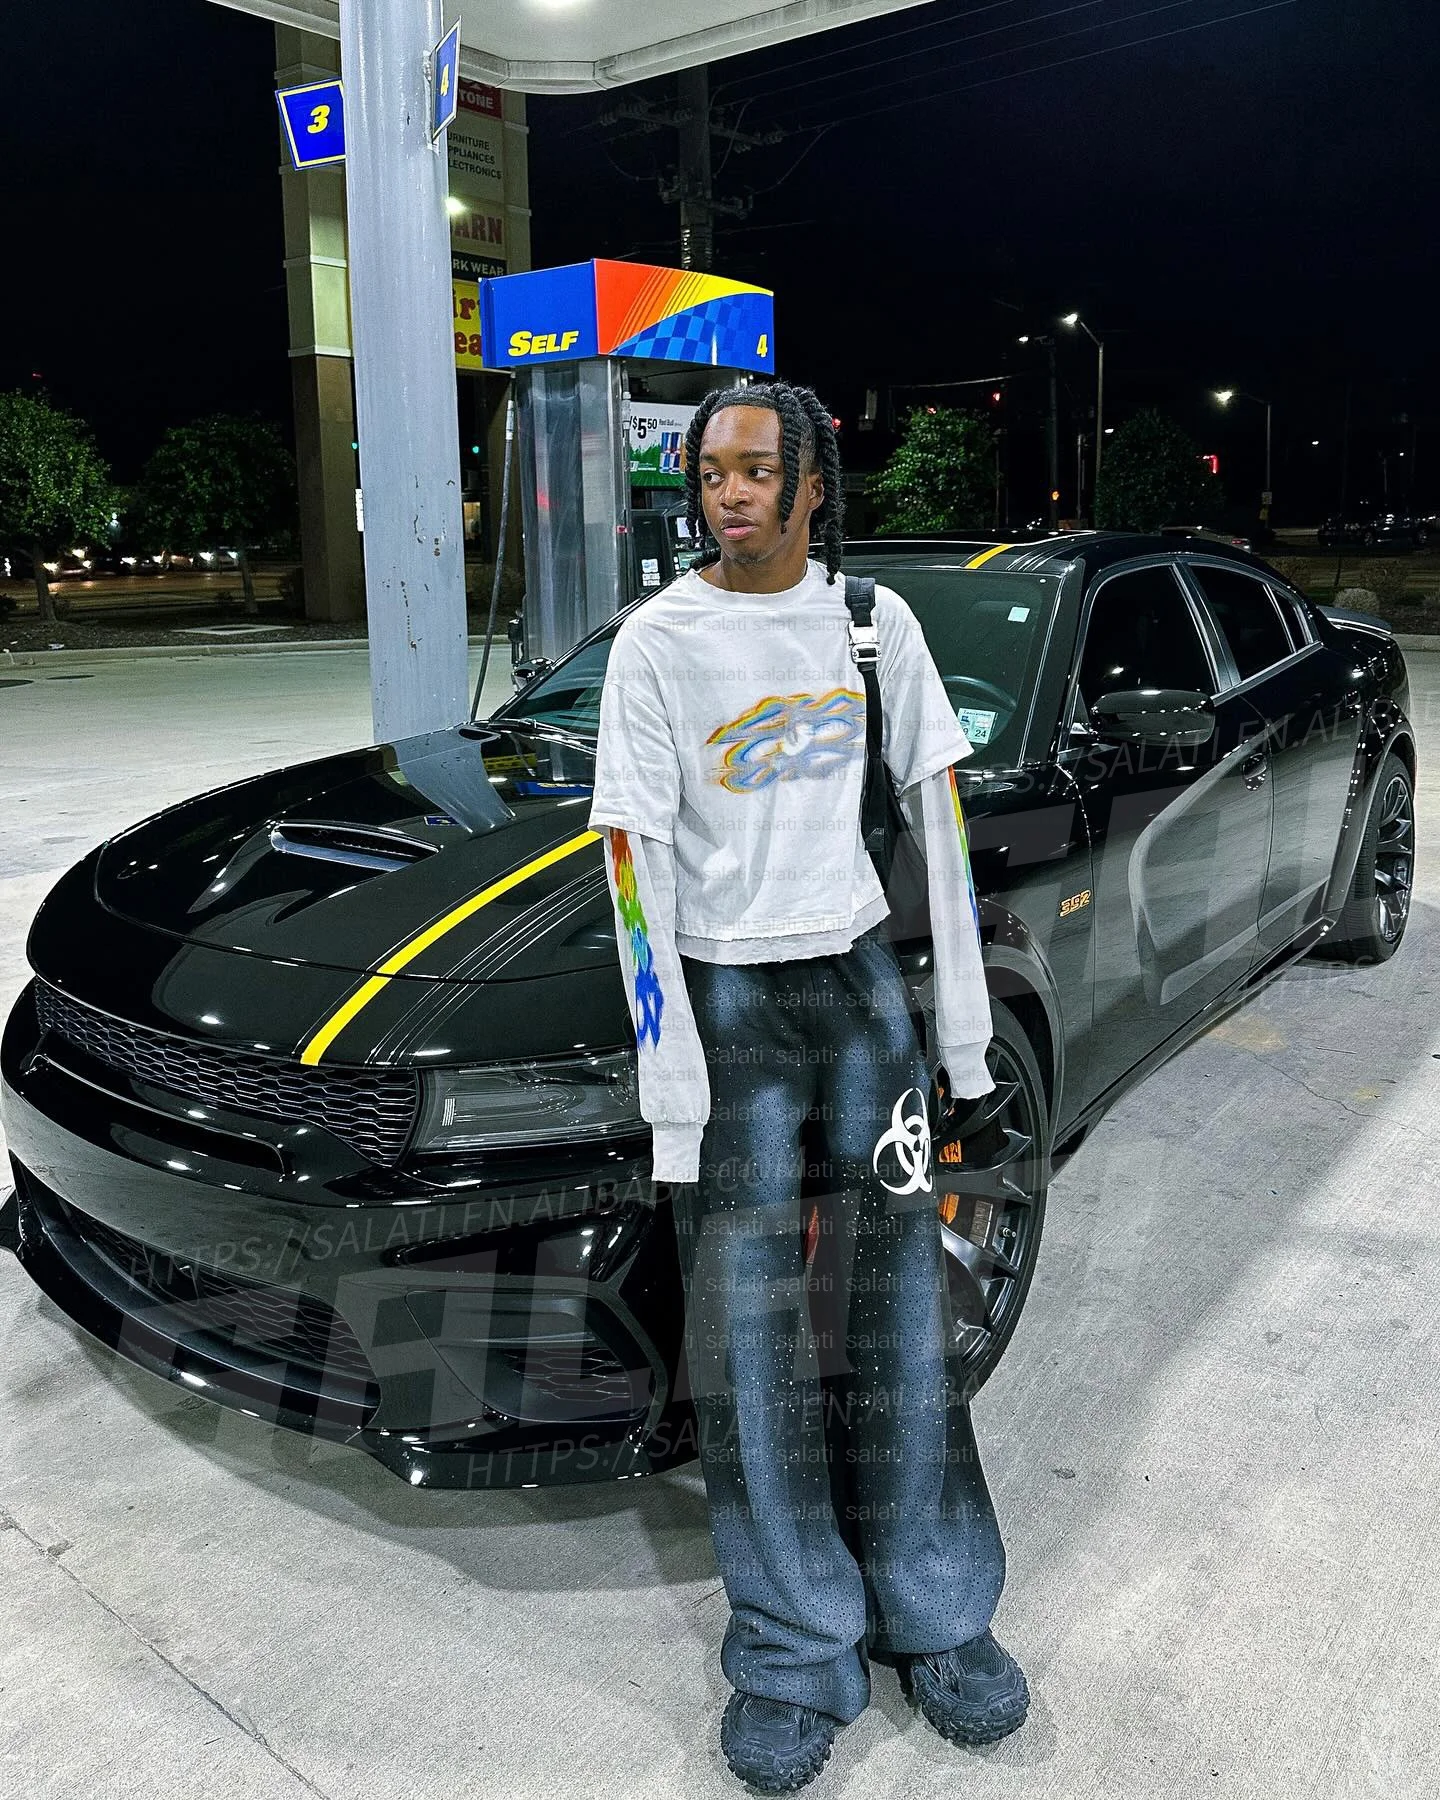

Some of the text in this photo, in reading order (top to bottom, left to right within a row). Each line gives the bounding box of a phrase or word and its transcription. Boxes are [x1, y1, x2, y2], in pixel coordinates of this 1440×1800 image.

[458, 89, 494, 110] TONE
[307, 105, 331, 134] 3
[447, 132, 490, 150] URNITURE
[448, 145, 496, 165] PPLIANCES
[448, 158, 503, 179] LECTRONICS
[454, 212, 503, 245] ARN
[453, 258, 504, 277] RK WEAR
[508, 330, 580, 357] SELF
[756, 334, 768, 358] 4
[975, 729, 987, 738] 24
